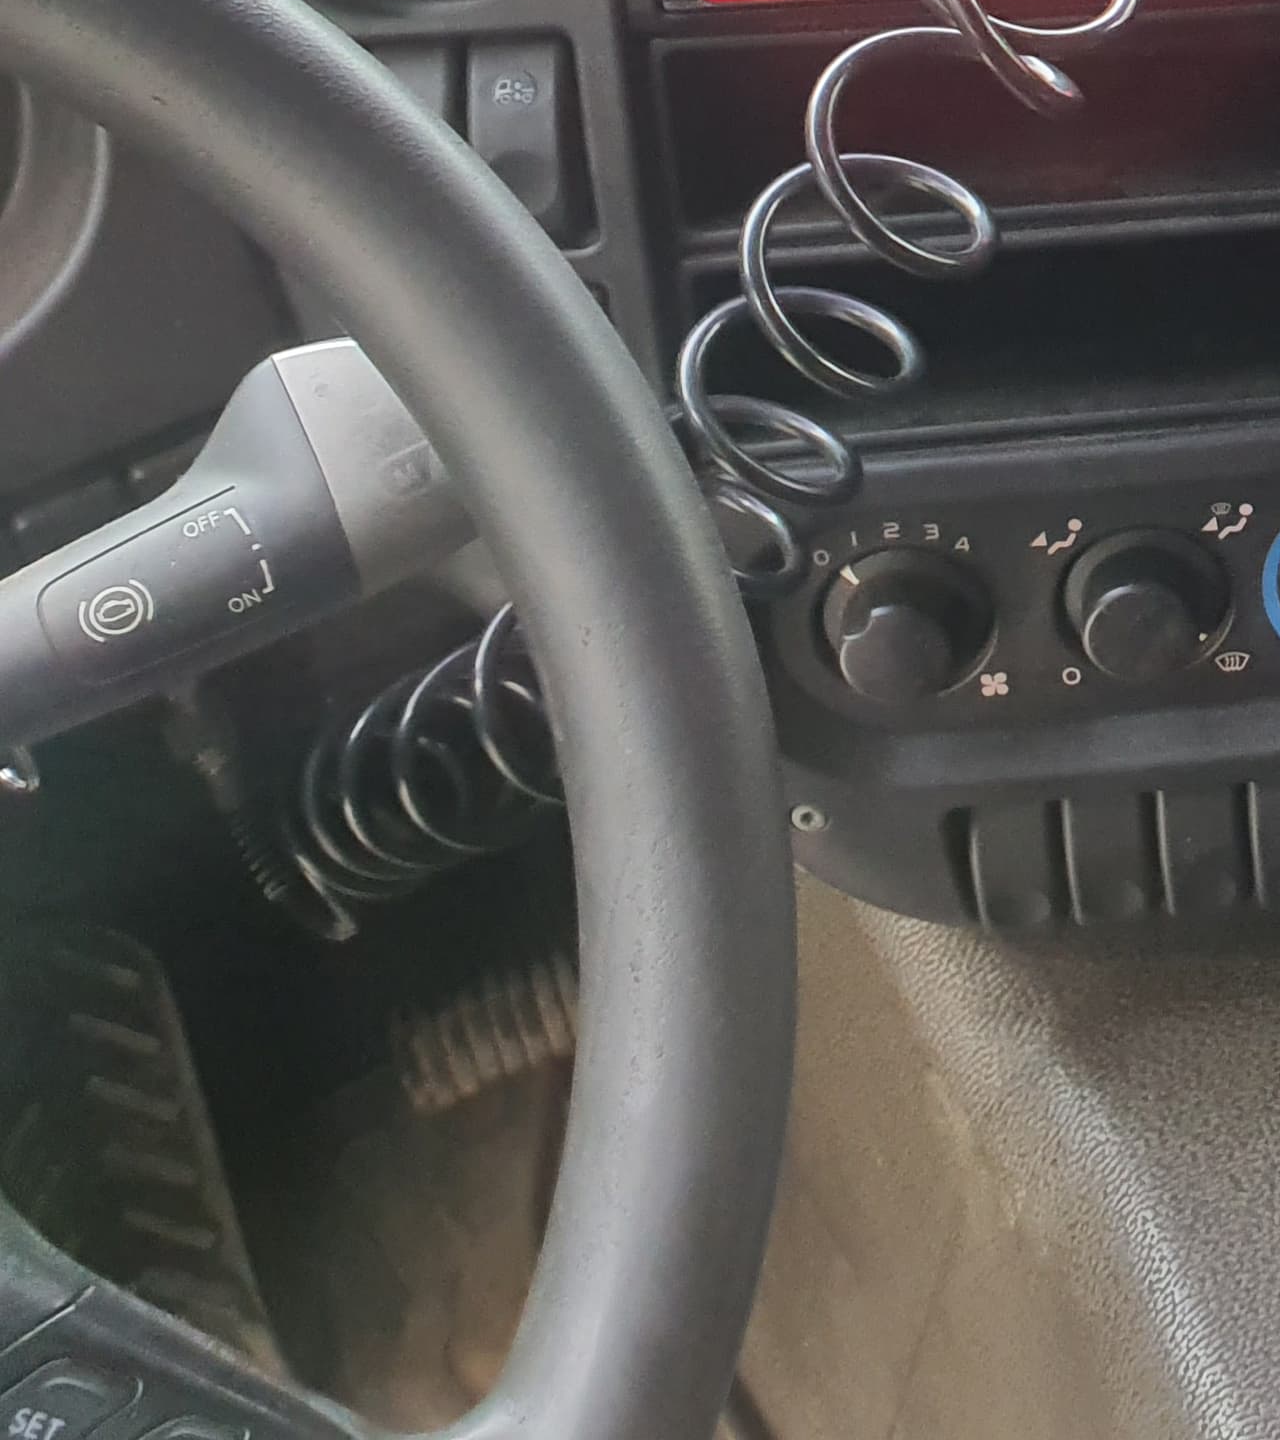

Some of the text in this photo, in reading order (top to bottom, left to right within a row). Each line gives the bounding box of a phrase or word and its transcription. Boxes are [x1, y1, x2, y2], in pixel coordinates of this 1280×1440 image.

[181, 511, 221, 540] OFF
[849, 531, 859, 547] 1
[883, 521, 901, 540] 2
[924, 523, 940, 541] 3
[954, 535, 971, 553] 4
[227, 588, 262, 615] ON
[8, 1407, 66, 1440] SET
